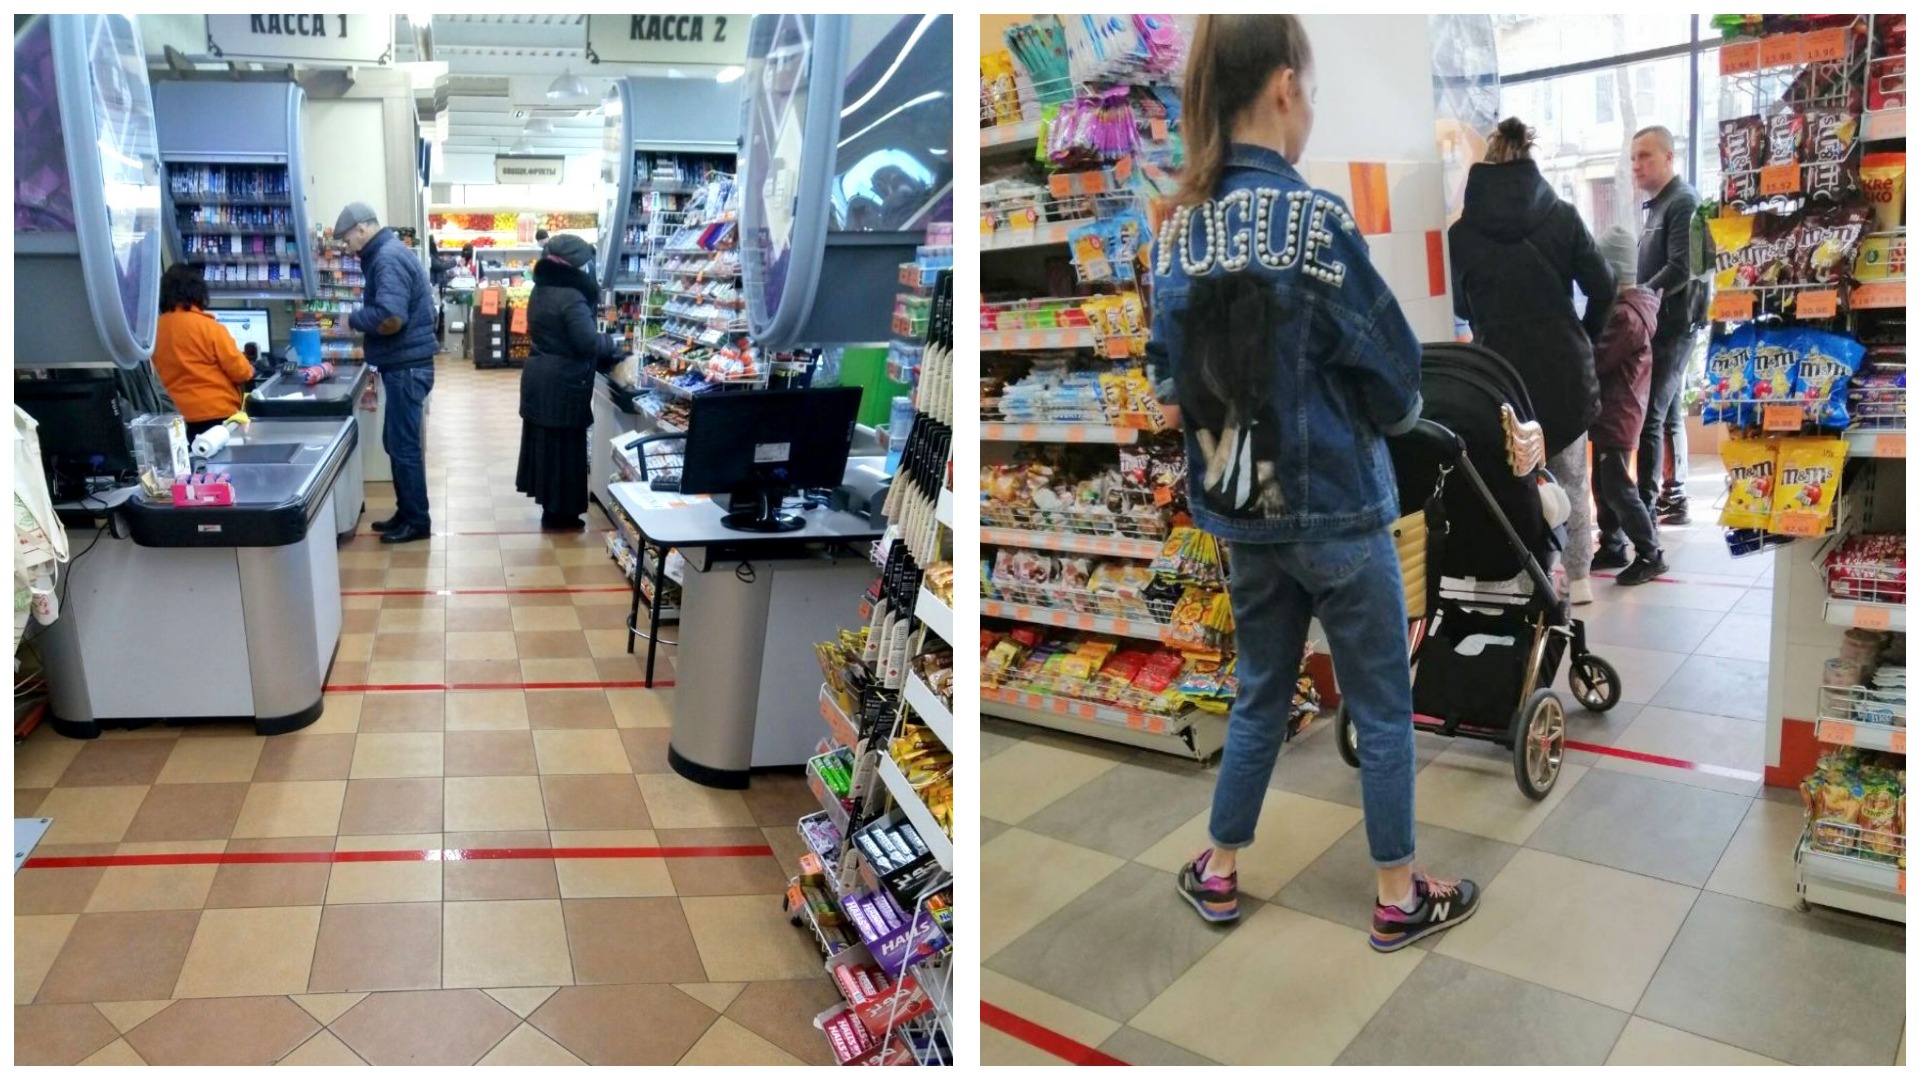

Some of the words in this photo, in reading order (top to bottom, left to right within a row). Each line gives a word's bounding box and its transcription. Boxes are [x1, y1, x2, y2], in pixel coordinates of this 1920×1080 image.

[251, 14, 326, 36] КАССА
[338, 14, 348, 37] 1
[630, 14, 703, 41] КАССА
[714, 16, 728, 42] 2
[1156, 187, 1354, 288] VOGUE
[1430, 902, 1450, 922] N
[828, 1026, 847, 1052] HALLS
[838, 1021, 856, 1046] HALLS
